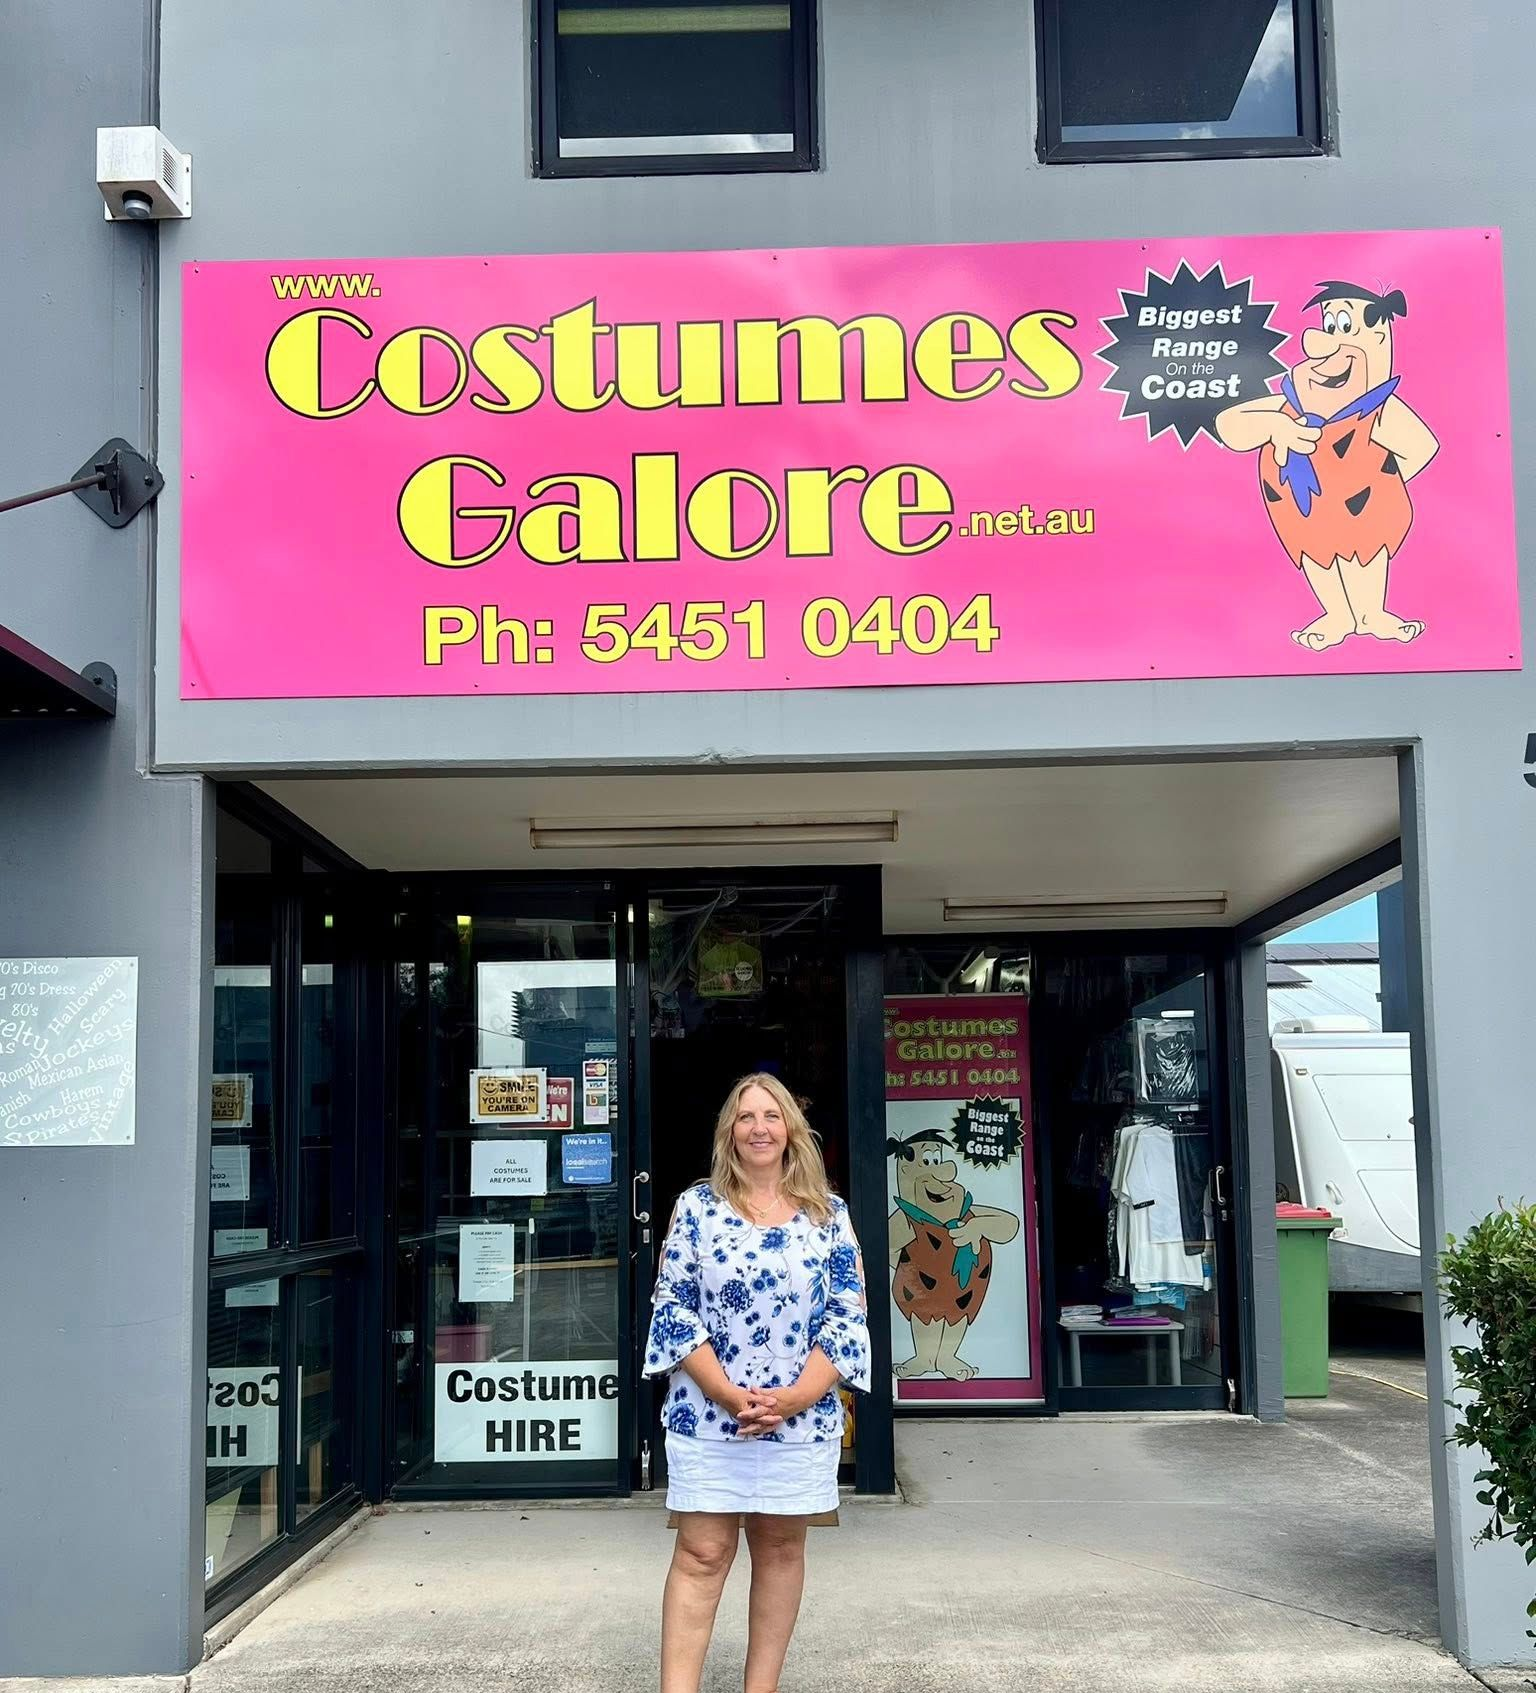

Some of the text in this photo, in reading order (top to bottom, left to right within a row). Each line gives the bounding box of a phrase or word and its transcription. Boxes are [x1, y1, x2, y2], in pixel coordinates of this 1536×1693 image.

[270, 272, 382, 299] www.
[1137, 303, 1243, 329] Biggest
[265, 296, 1083, 420] Costumes
[1151, 336, 1239, 361] Range
[1165, 360, 1214, 376] On the
[1141, 374, 1241, 401] Coast
[397, 451, 1096, 569] Galore .net.au
[423, 592, 1000, 666] Ph: 5451 0404
[0, 961, 59, 975] 0's Disco
[11, 982, 36, 996] 70's
[39, 982, 76, 996] Dress
[47, 959, 123, 1036] Halloween
[11, 1003, 39, 1017] 80's
[79, 988, 127, 1034] Scary
[38, 1017, 136, 1073] Jockeys
[896, 1038, 995, 1062] Galore
[0, 1058, 42, 1088] Roman
[27, 1053, 126, 1090] Mexican Asian
[910, 1069, 959, 1087] 5451
[967, 1067, 1021, 1085] 0404
[59, 1084, 104, 1106] Harem
[87, 1060, 135, 1144] Vintage
[482, 1095, 536, 1105] YOU'RE ON
[4, 1098, 101, 1129] Cowboys
[487, 1104, 529, 1113] CAMERA
[967, 1108, 1009, 1123] Biggest
[969, 1121, 1004, 1137] Range
[966, 1140, 1004, 1158] Coast
[446, 1367, 619, 1404] Costume
[485, 1418, 582, 1454] HIRE
